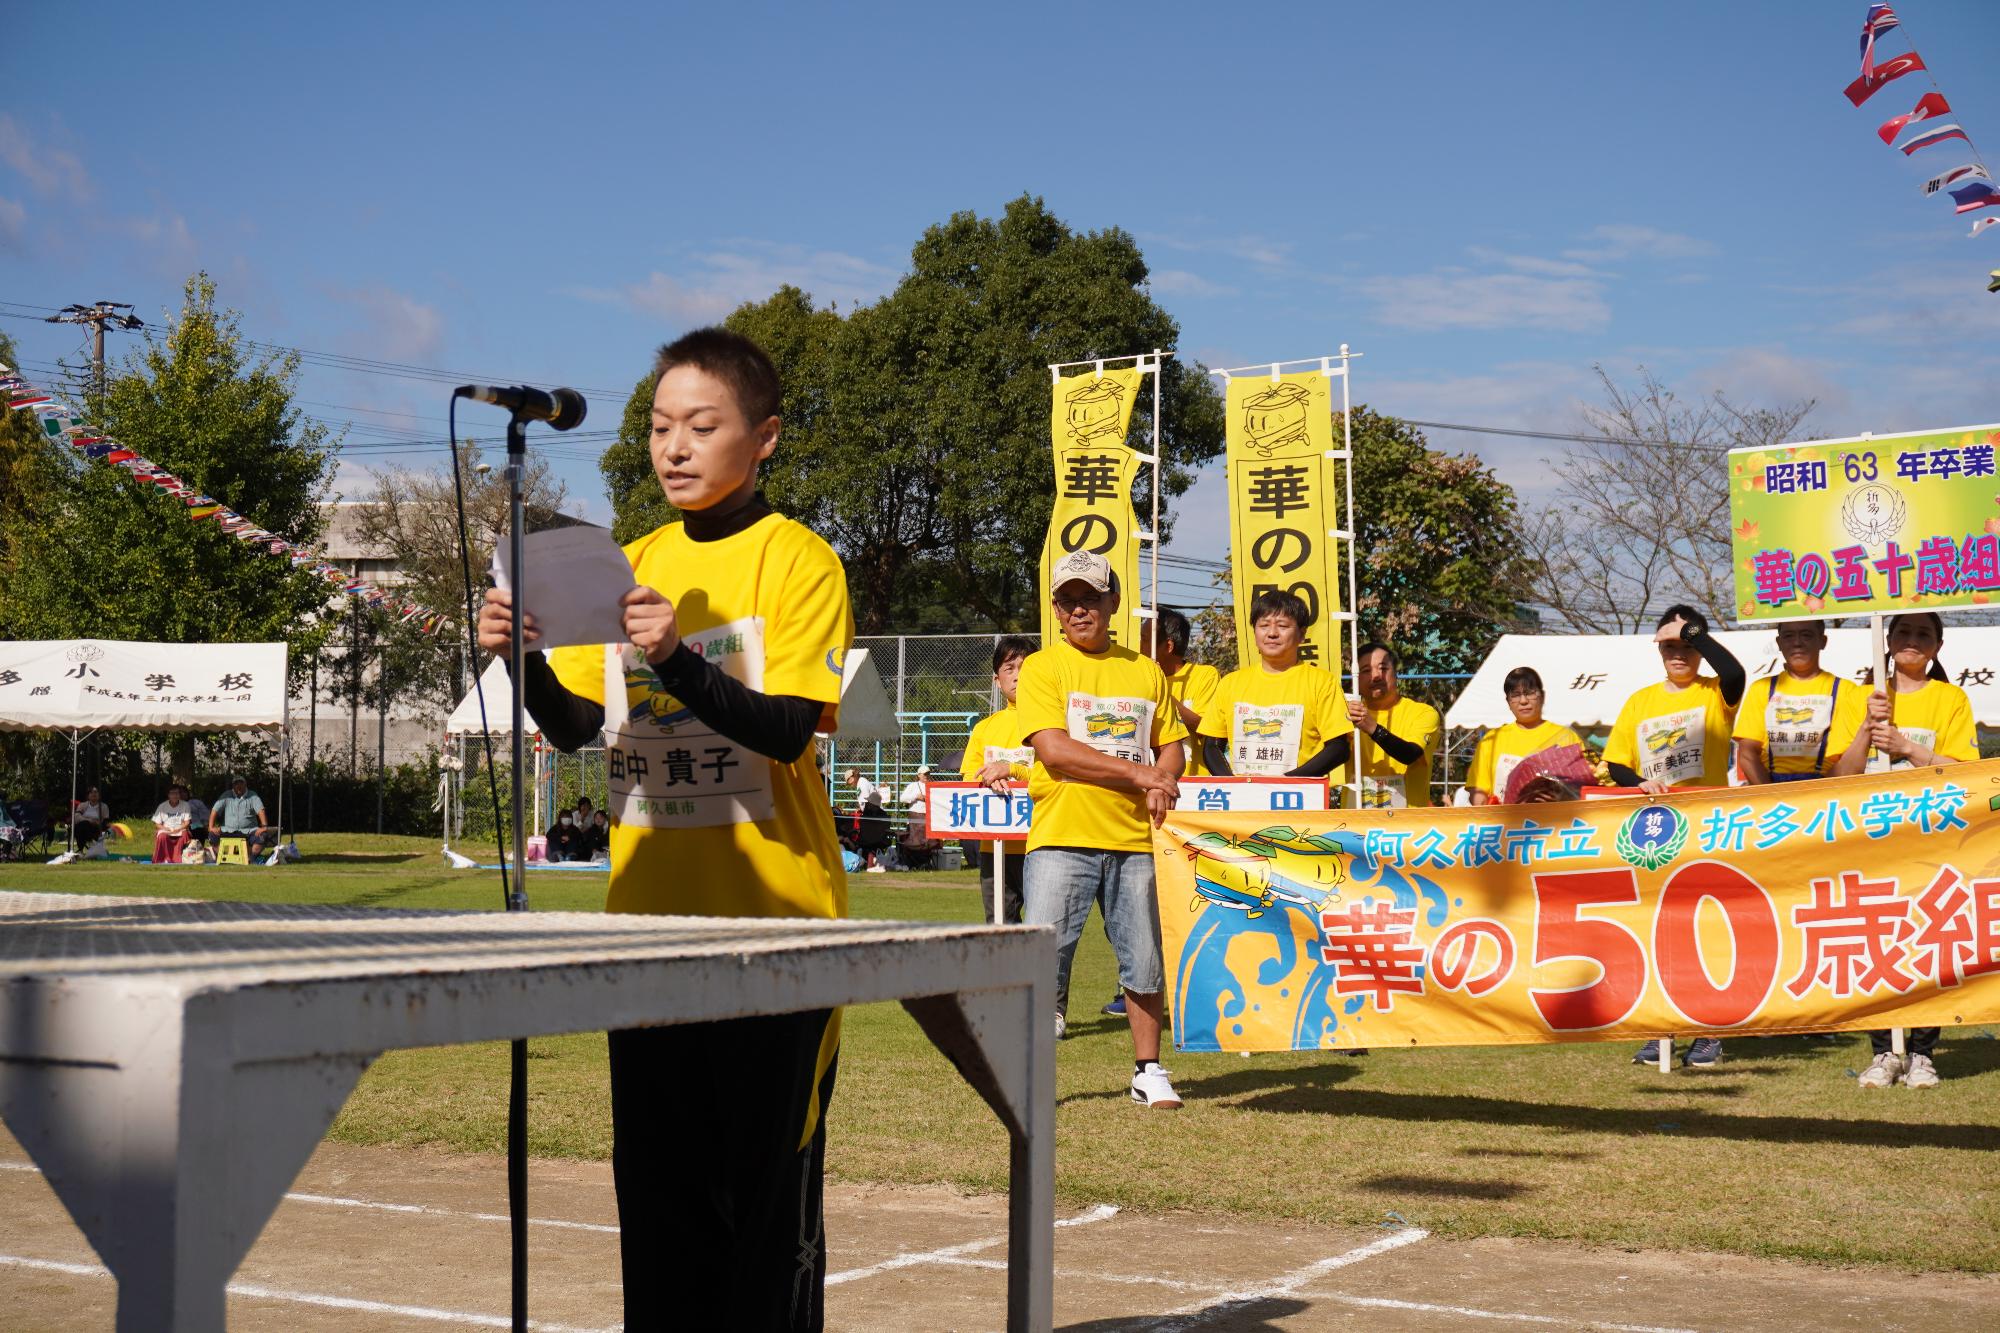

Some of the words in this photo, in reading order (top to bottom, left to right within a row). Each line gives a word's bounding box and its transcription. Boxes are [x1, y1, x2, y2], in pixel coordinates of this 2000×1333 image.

[1766, 461, 1828, 494] 昭和
[1844, 451, 1878, 483] 63
[1897, 445, 1995, 482] 年卒業
[1753, 534, 2000, 606] 華の五十歳組
[610, 748, 648, 785] 田中
[662, 747, 739, 787] 貴子
[637, 800, 696, 816] 阿久根市
[1698, 782, 1969, 853] 折多小学校
[1363, 816, 1603, 871] 阿久根市立
[1318, 858, 2000, 1033] 華の50歳組
